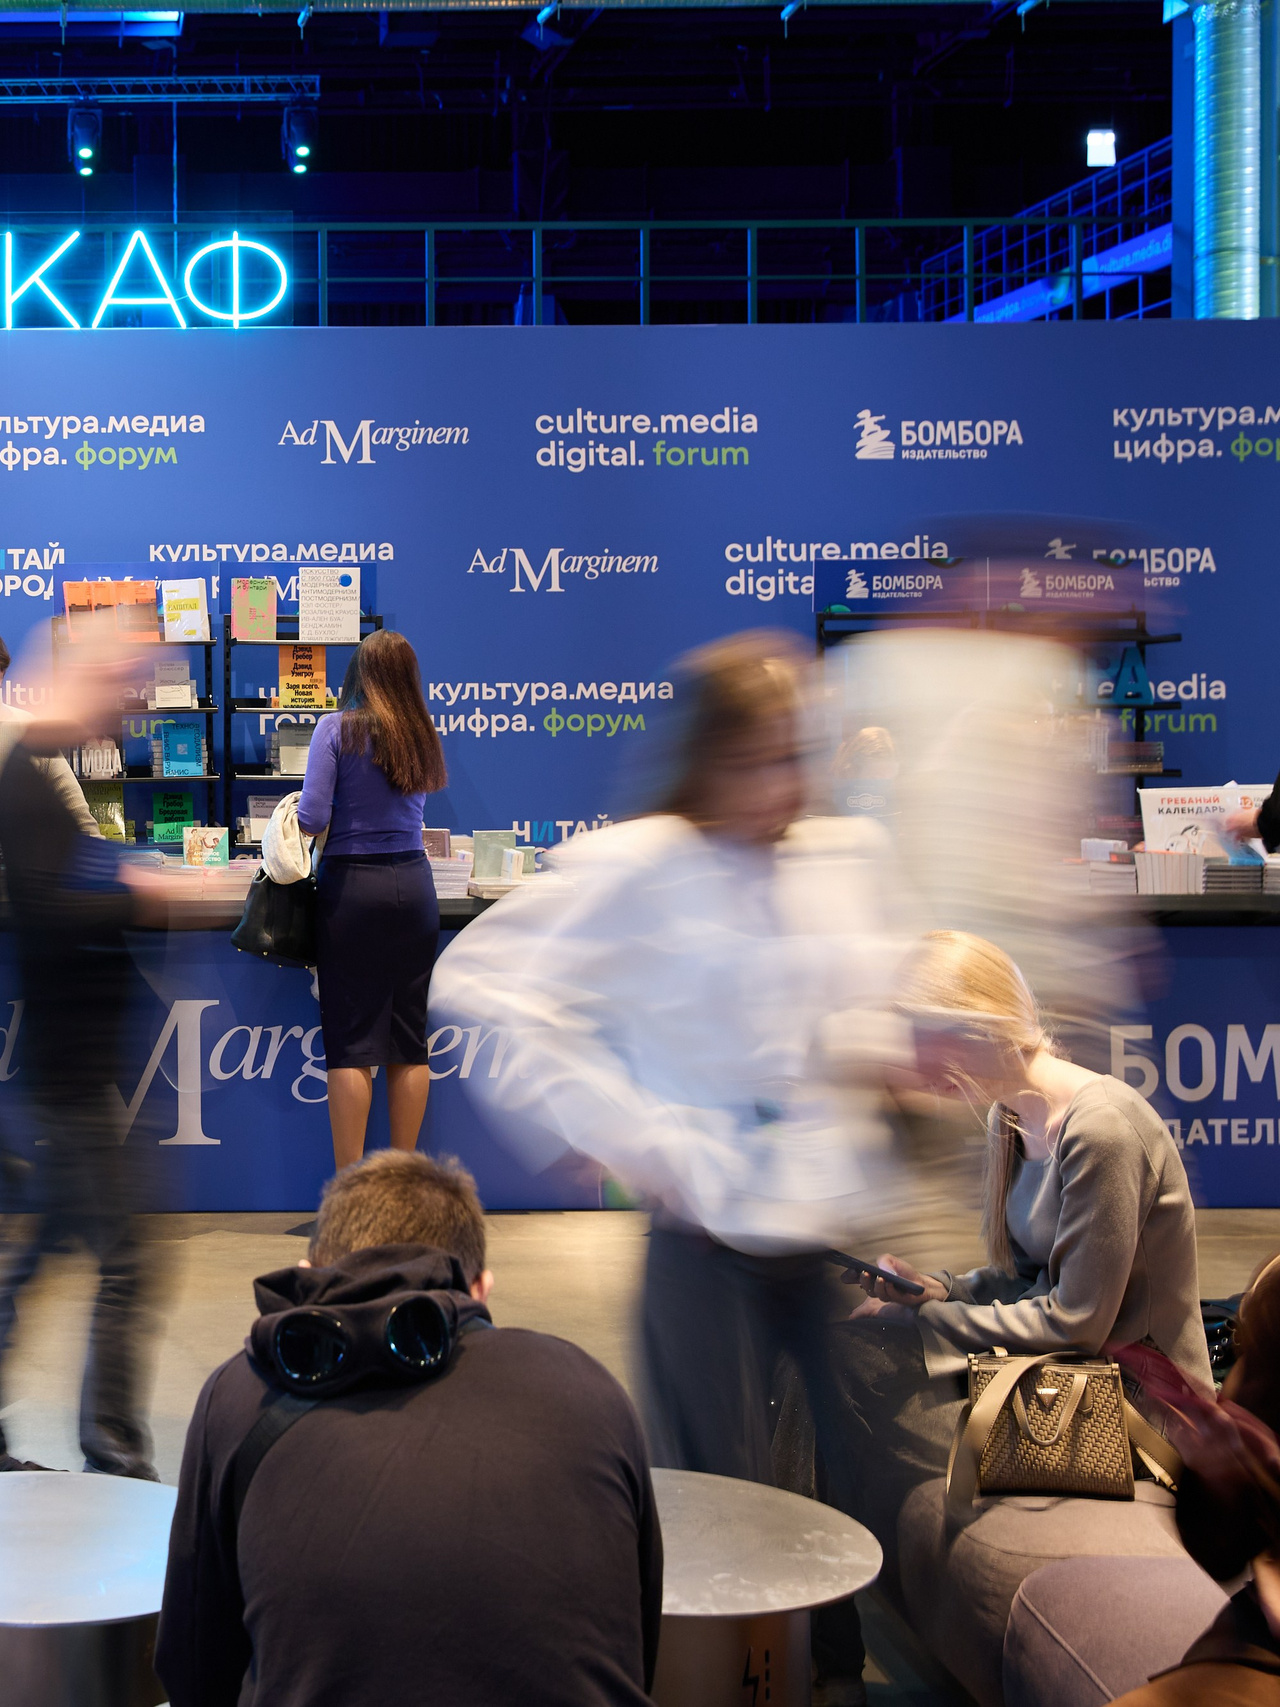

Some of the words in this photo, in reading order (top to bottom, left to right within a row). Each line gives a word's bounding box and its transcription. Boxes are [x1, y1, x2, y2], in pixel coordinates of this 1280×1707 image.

[534, 407, 759, 435] culture.media
[278, 419, 318, 446] Ad
[320, 419, 470, 464] Marginem
[900, 419, 1024, 447] БОМБОРА
[74, 441, 178, 471] форум
[535, 440, 645, 473] digital.
[652, 440, 750, 467] forum
[900, 448, 988, 461] ИЗДАТЕЛЬСТВО
[1113, 432, 1223, 464] цифра.
[1230, 431, 1280, 463] фо
[148, 541, 395, 562] культура.медиа
[724, 536, 949, 562] culture.media
[467, 547, 507, 574] Ad
[508, 547, 659, 593] Marginem
[872, 575, 944, 591] БОМБОРА
[1045, 574, 1115, 591] БОМБОРА
[872, 591, 923, 599] ИЗДАТЕЛЬСТВО
[1045, 590, 1095, 598] ИЗДАТЕЛЬСТВО
[292, 645, 313, 654] Дэвид
[292, 653, 313, 661] Гребер
[292, 662, 313, 671] Дэвид
[428, 681, 674, 706] культура.медиа
[430, 707, 536, 738] цифра.
[542, 707, 646, 737] форум
[81, 748, 123, 777] МОДА
[1157, 806, 1226, 815] КАЛЕНДАРЬ
[1160, 795, 1220, 806] ГРЕБАНЫЙ
[157, 833, 183, 841] Margine
